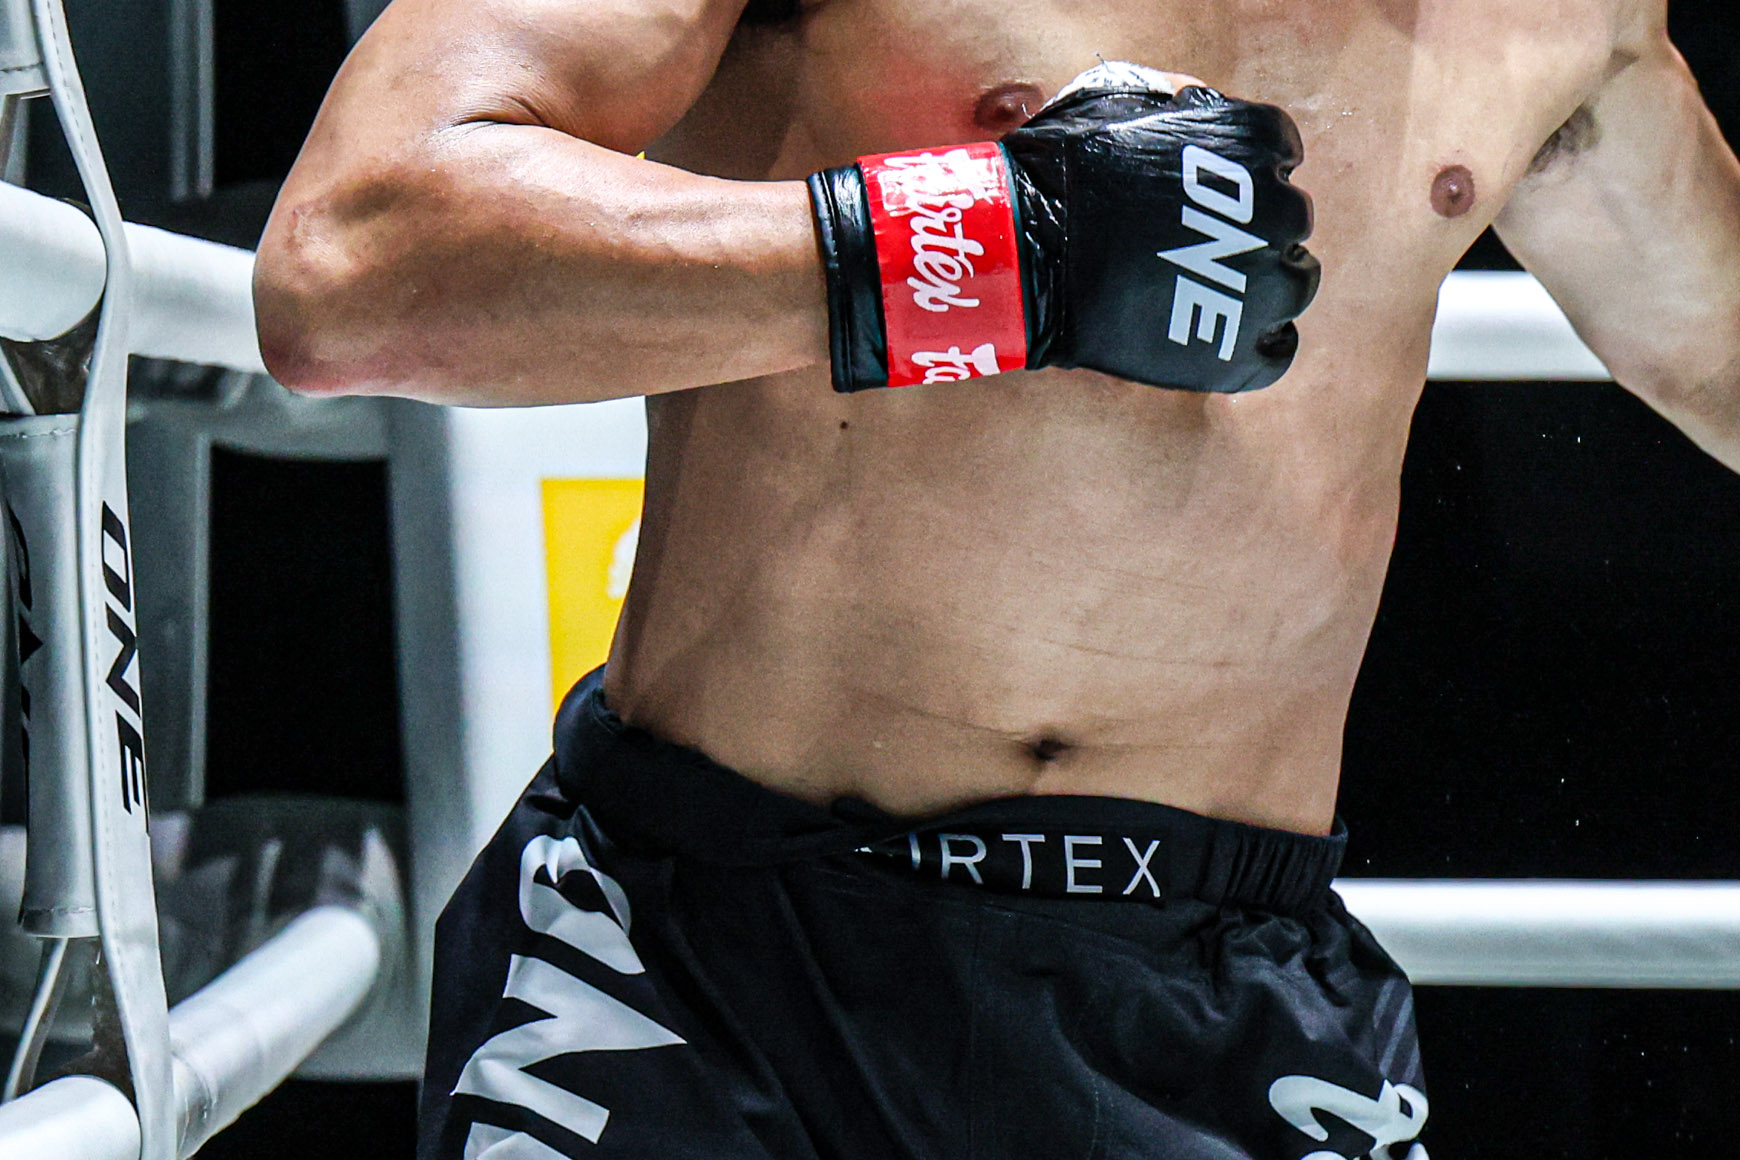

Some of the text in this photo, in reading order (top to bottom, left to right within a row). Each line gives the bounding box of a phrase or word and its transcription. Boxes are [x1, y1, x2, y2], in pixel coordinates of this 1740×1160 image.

[1157, 144, 1269, 361] ONE
[102, 501, 150, 837] ONE
[450, 834, 687, 1160] ON
[854, 833, 1161, 898] IRTEX
